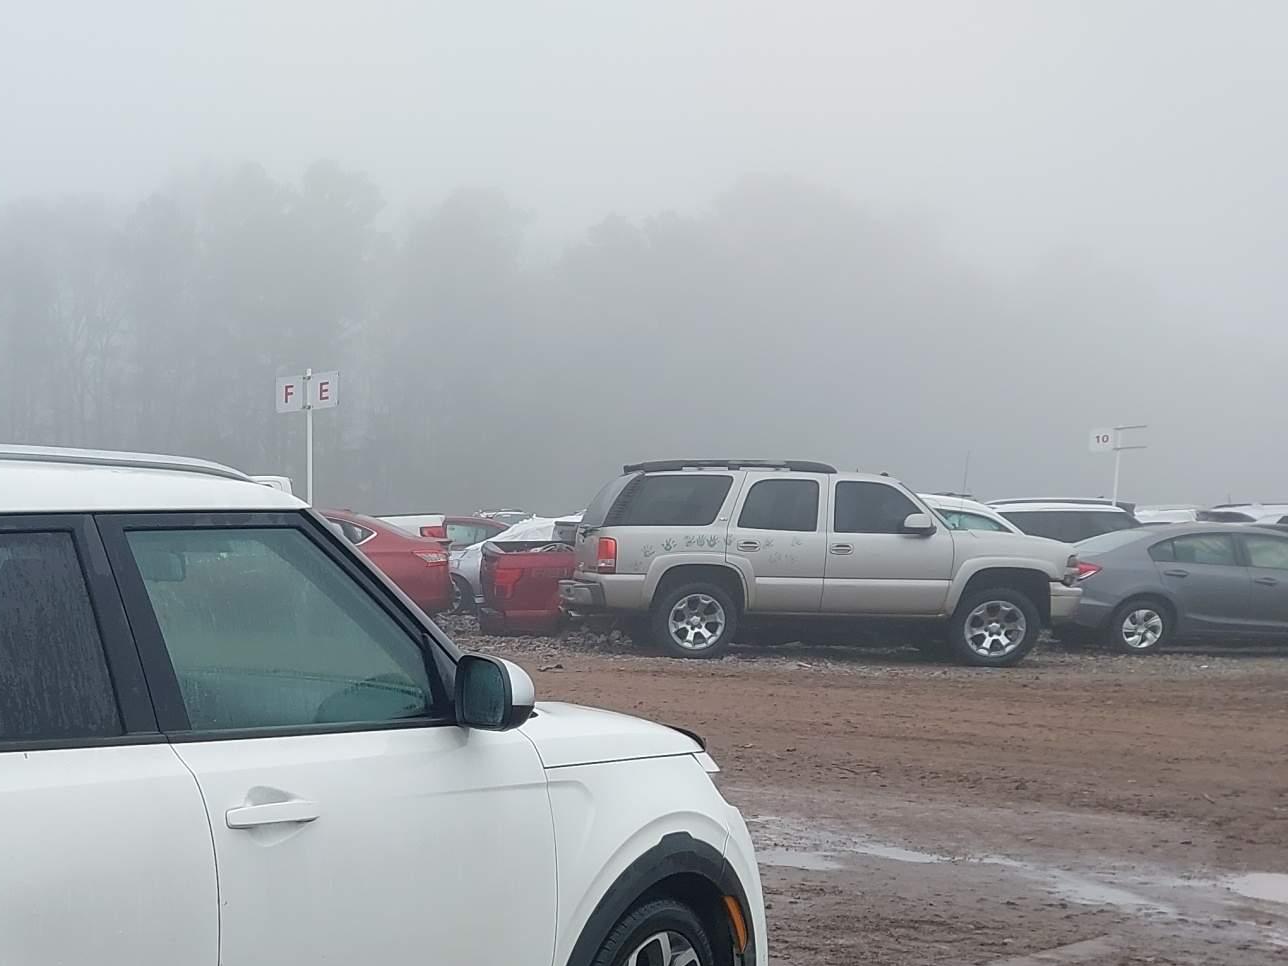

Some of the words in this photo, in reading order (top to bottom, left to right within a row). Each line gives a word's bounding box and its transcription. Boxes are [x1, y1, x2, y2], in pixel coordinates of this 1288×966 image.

[284, 384, 294, 403] F
[319, 381, 330, 401] E
[1095, 434, 1110, 444] 10
